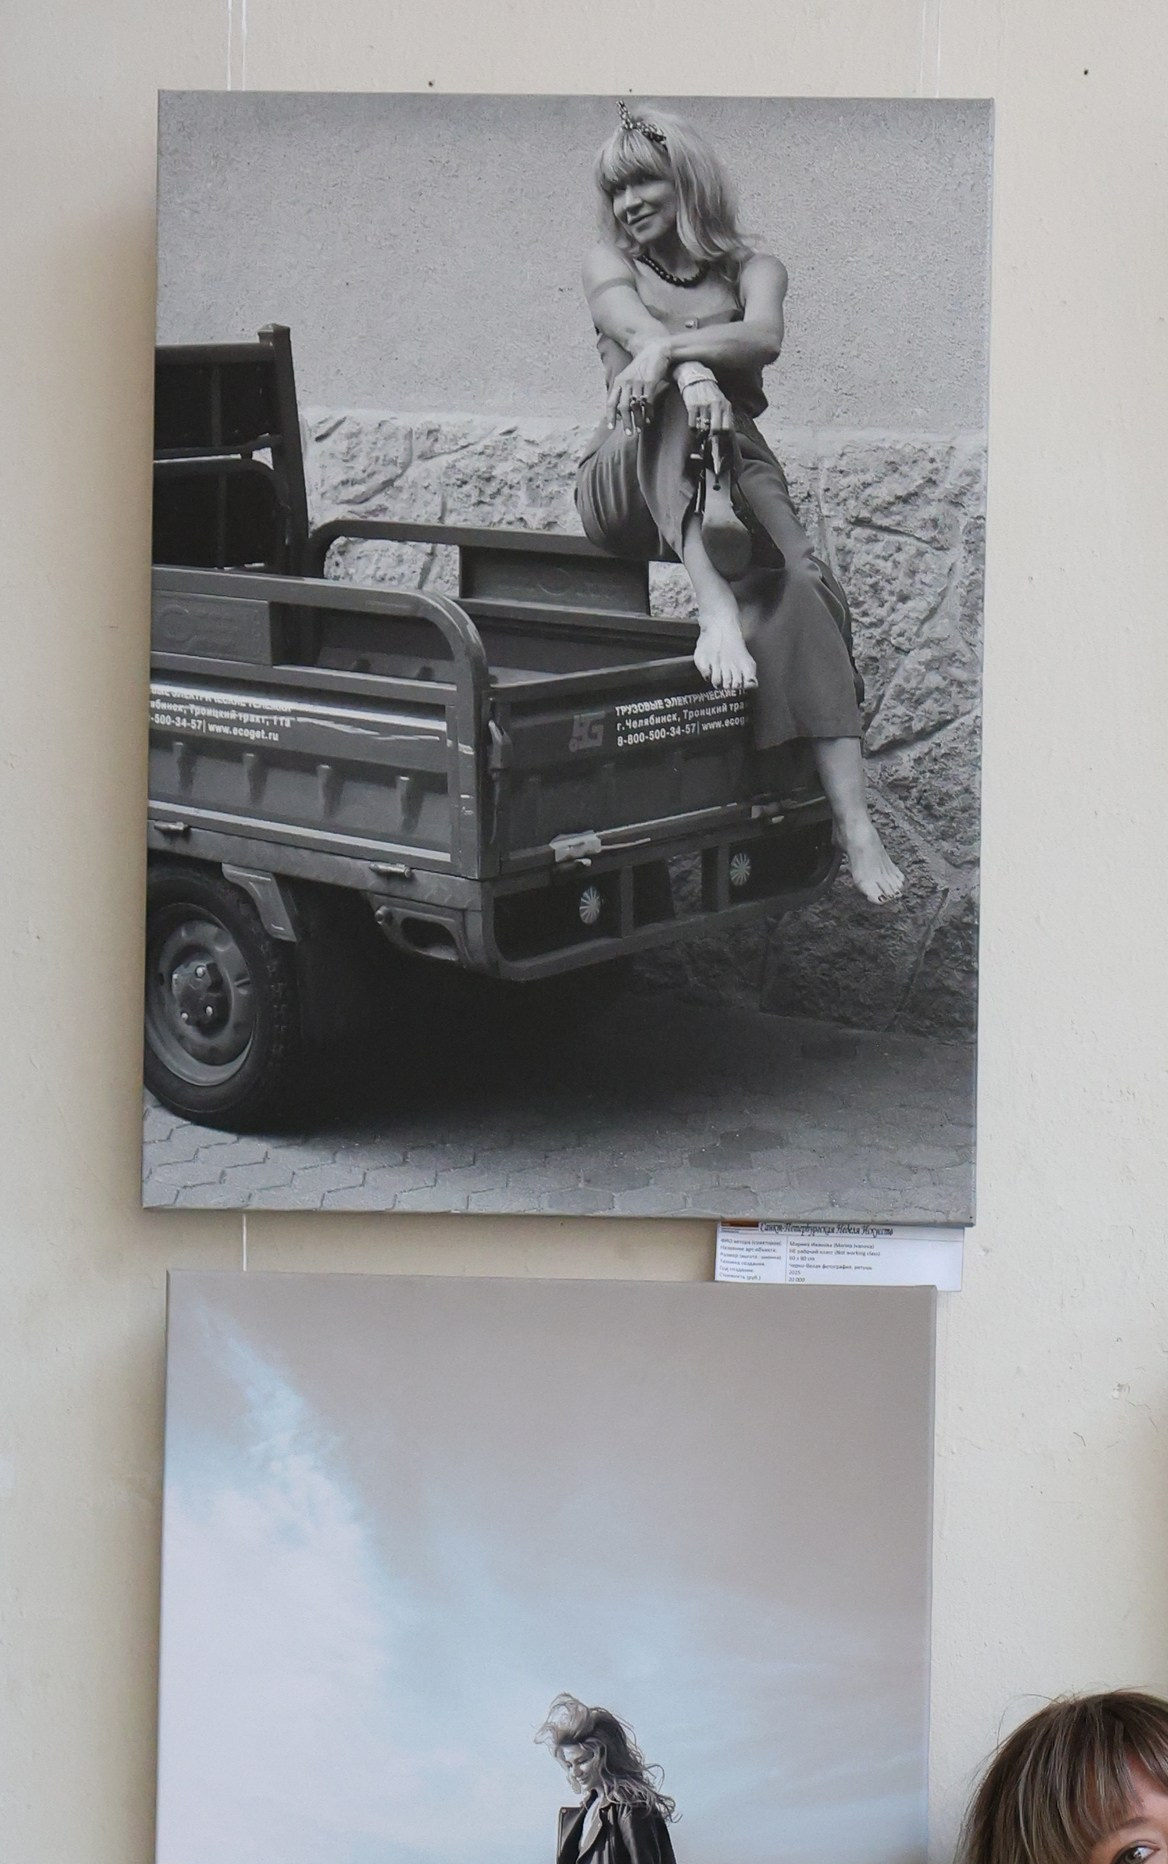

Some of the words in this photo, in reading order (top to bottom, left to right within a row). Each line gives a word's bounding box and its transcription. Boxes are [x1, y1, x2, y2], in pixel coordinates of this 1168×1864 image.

[615, 700, 664, 718] ГРУЗОВЫЕ
[683, 702, 728, 722] Троицкий
[208, 722, 279, 741] www.ecoget.ru
